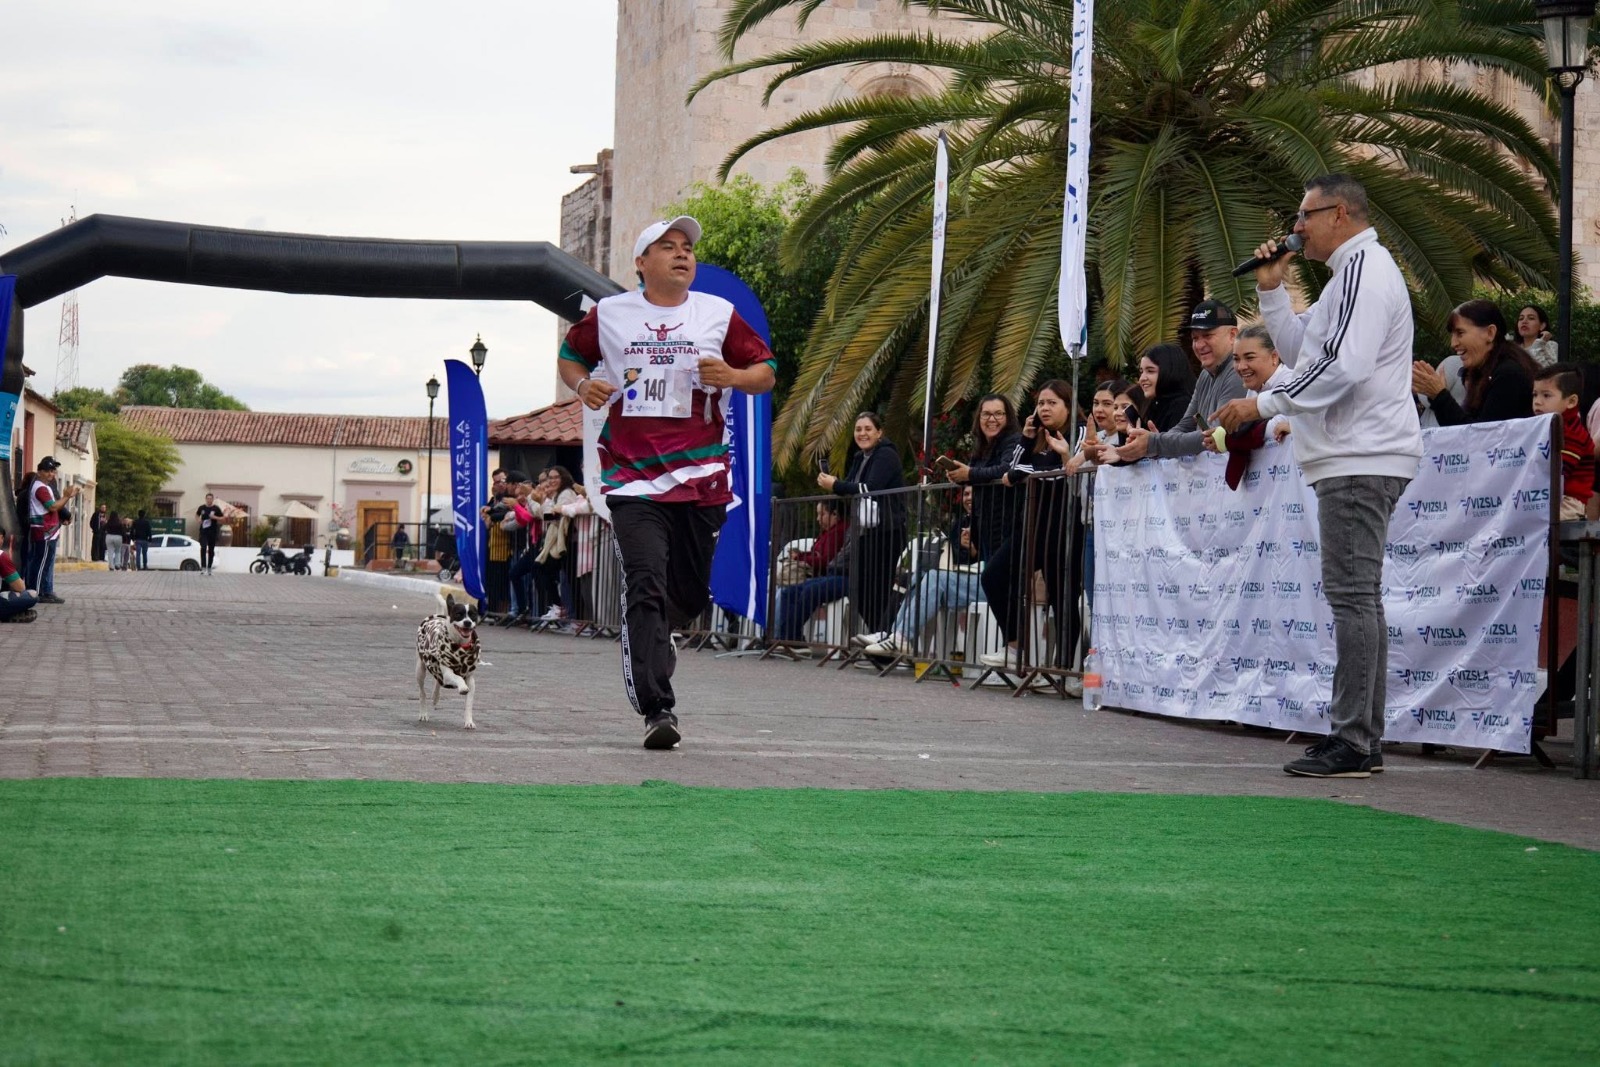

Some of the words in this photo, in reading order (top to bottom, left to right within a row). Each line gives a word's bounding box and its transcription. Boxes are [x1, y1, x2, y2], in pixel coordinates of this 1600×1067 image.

[624, 347, 644, 355] SAN
[646, 346, 700, 355] SEBASTIAN
[649, 354, 675, 365] 2026
[644, 378, 666, 402] 140
[726, 405, 737, 465] SILVER
[1497, 447, 1527, 459] VIZSLA
[456, 420, 466, 508] VIZSLA
[1444, 454, 1470, 465] VIZSLA
[1422, 501, 1448, 512] VIZSLA
[1471, 496, 1502, 508] VIZSLA
[1491, 536, 1526, 548] VIZSLA
[1465, 584, 1498, 595] VIZSLA
[1294, 622, 1317, 632] VIZSLA
[1431, 627, 1467, 638] VIZSLA
[1270, 661, 1295, 671] VIZSLA
[1457, 670, 1489, 681] VIZSLA
[1425, 709, 1456, 722] VIZSLA
